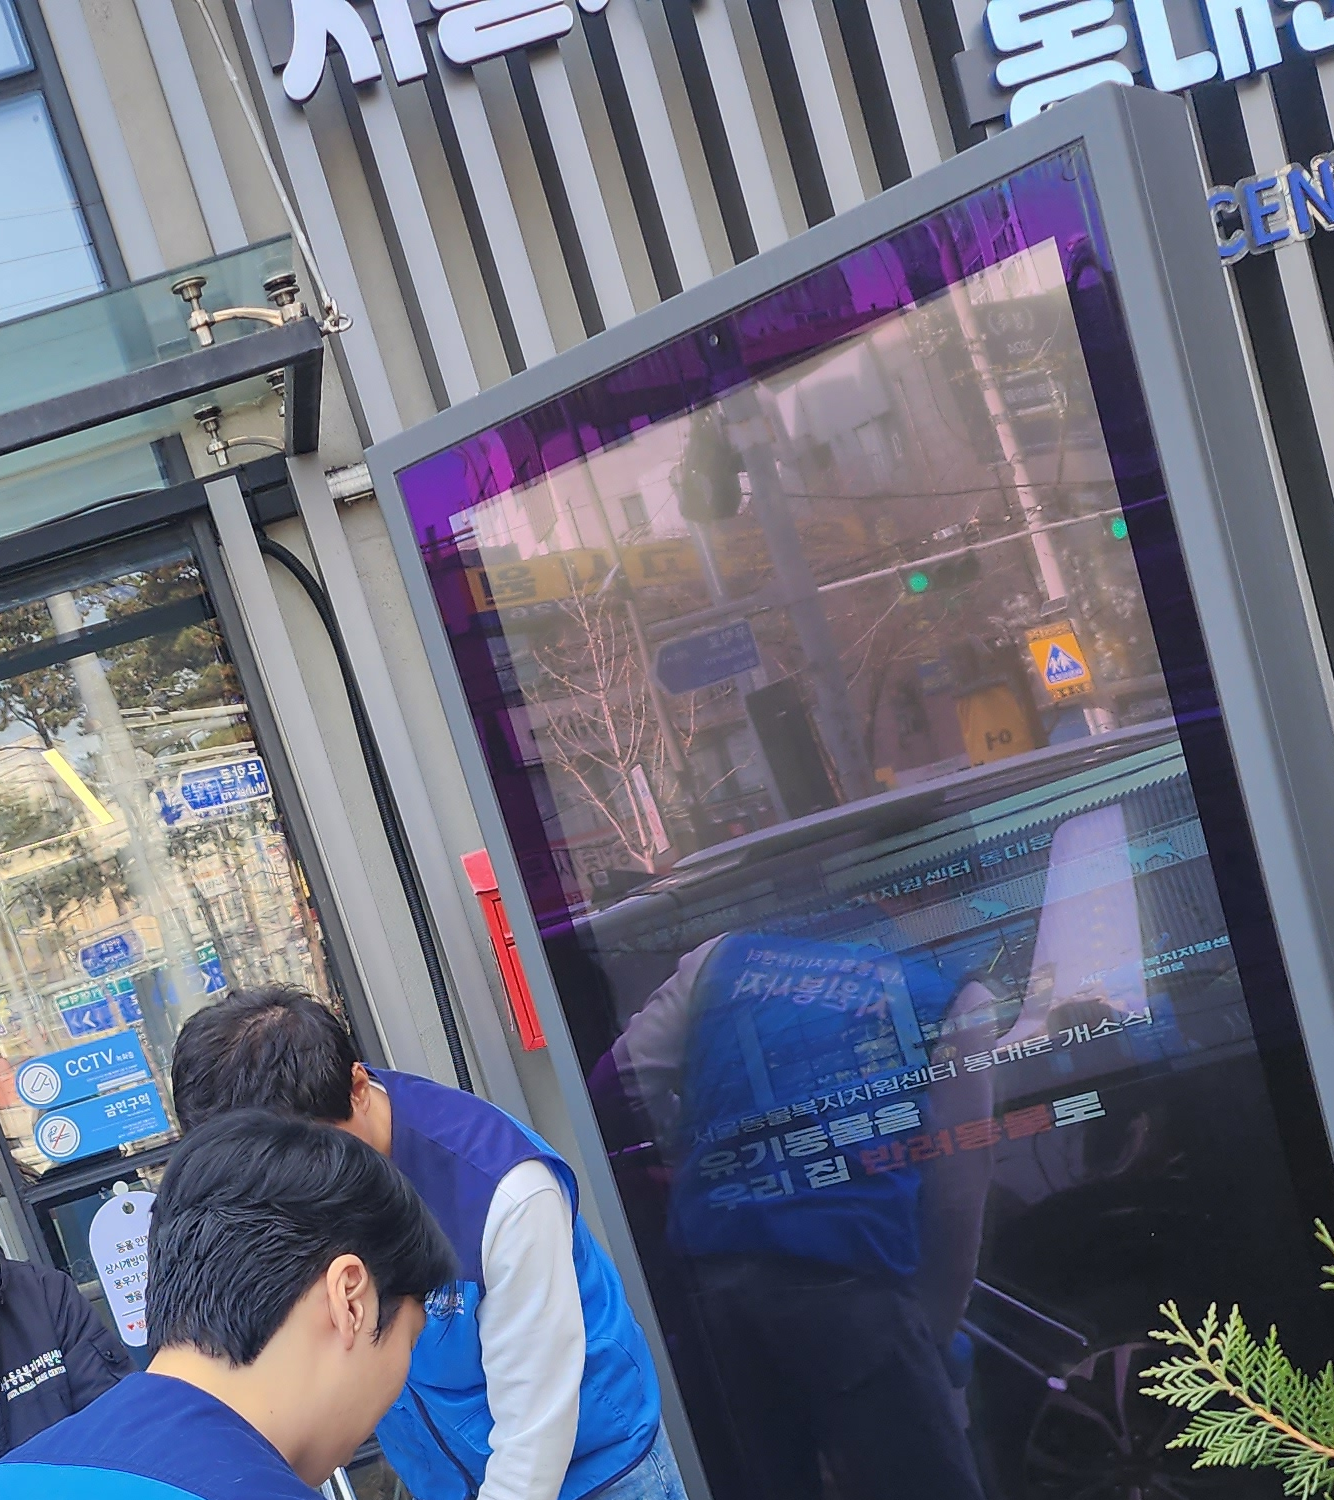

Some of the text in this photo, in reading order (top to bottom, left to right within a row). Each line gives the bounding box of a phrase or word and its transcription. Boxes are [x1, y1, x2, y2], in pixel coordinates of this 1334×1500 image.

[65, 1048, 113, 1077] CCTV
[690, 1006, 1153, 1147] 서울동물복지지원센터 동대문 개소식
[104, 1092, 152, 1118] 금연구역
[697, 1100, 922, 1180] 유기동물을
[707, 1090, 1107, 1211] 우리 집 반려동물로
